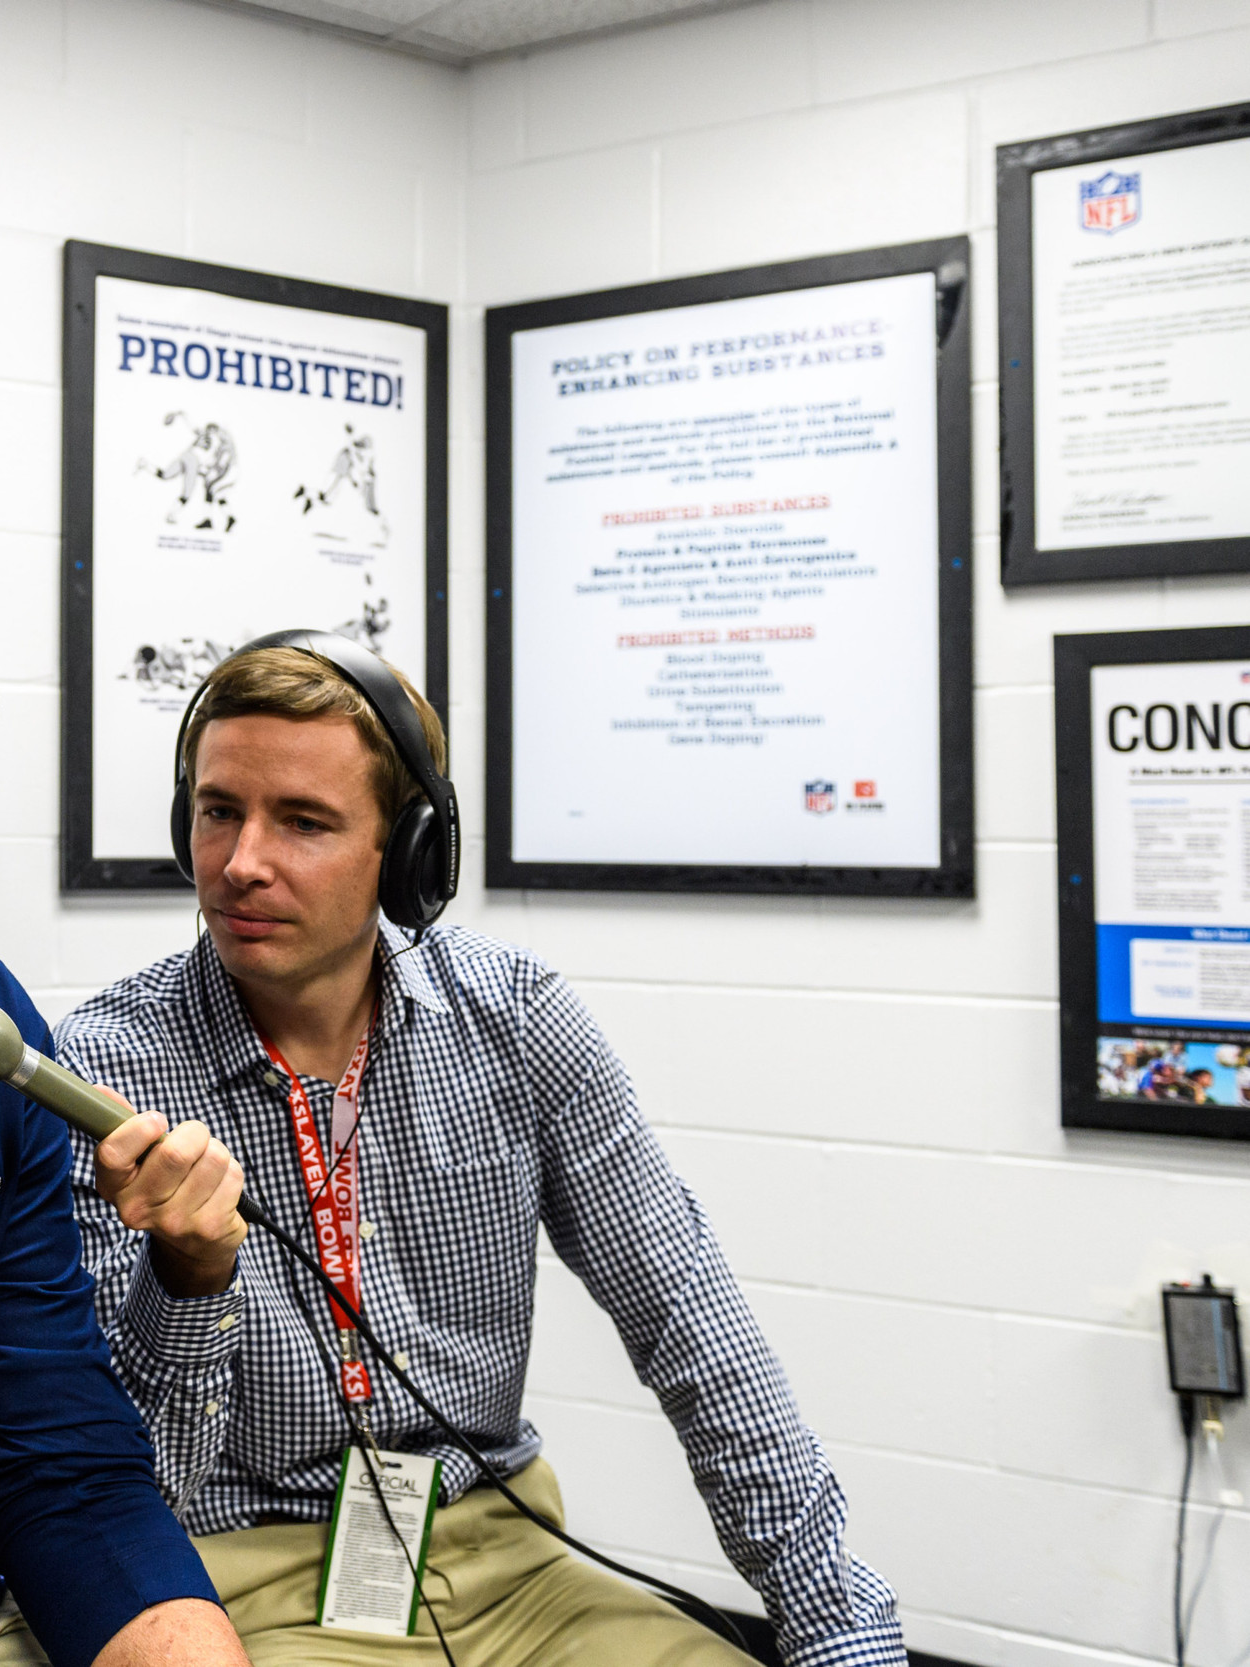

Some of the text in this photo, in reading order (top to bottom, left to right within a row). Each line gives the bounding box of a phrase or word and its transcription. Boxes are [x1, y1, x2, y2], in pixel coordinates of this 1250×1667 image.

[1085, 196, 1138, 227] NFL
[118, 333, 404, 411] PROHIBITED!
[552, 352, 633, 377] POLICY
[645, 346, 677, 364] ON
[557, 341, 886, 398] ENHANCING SUBSTANCES
[359, 1472, 417, 1493] OFICIAL
